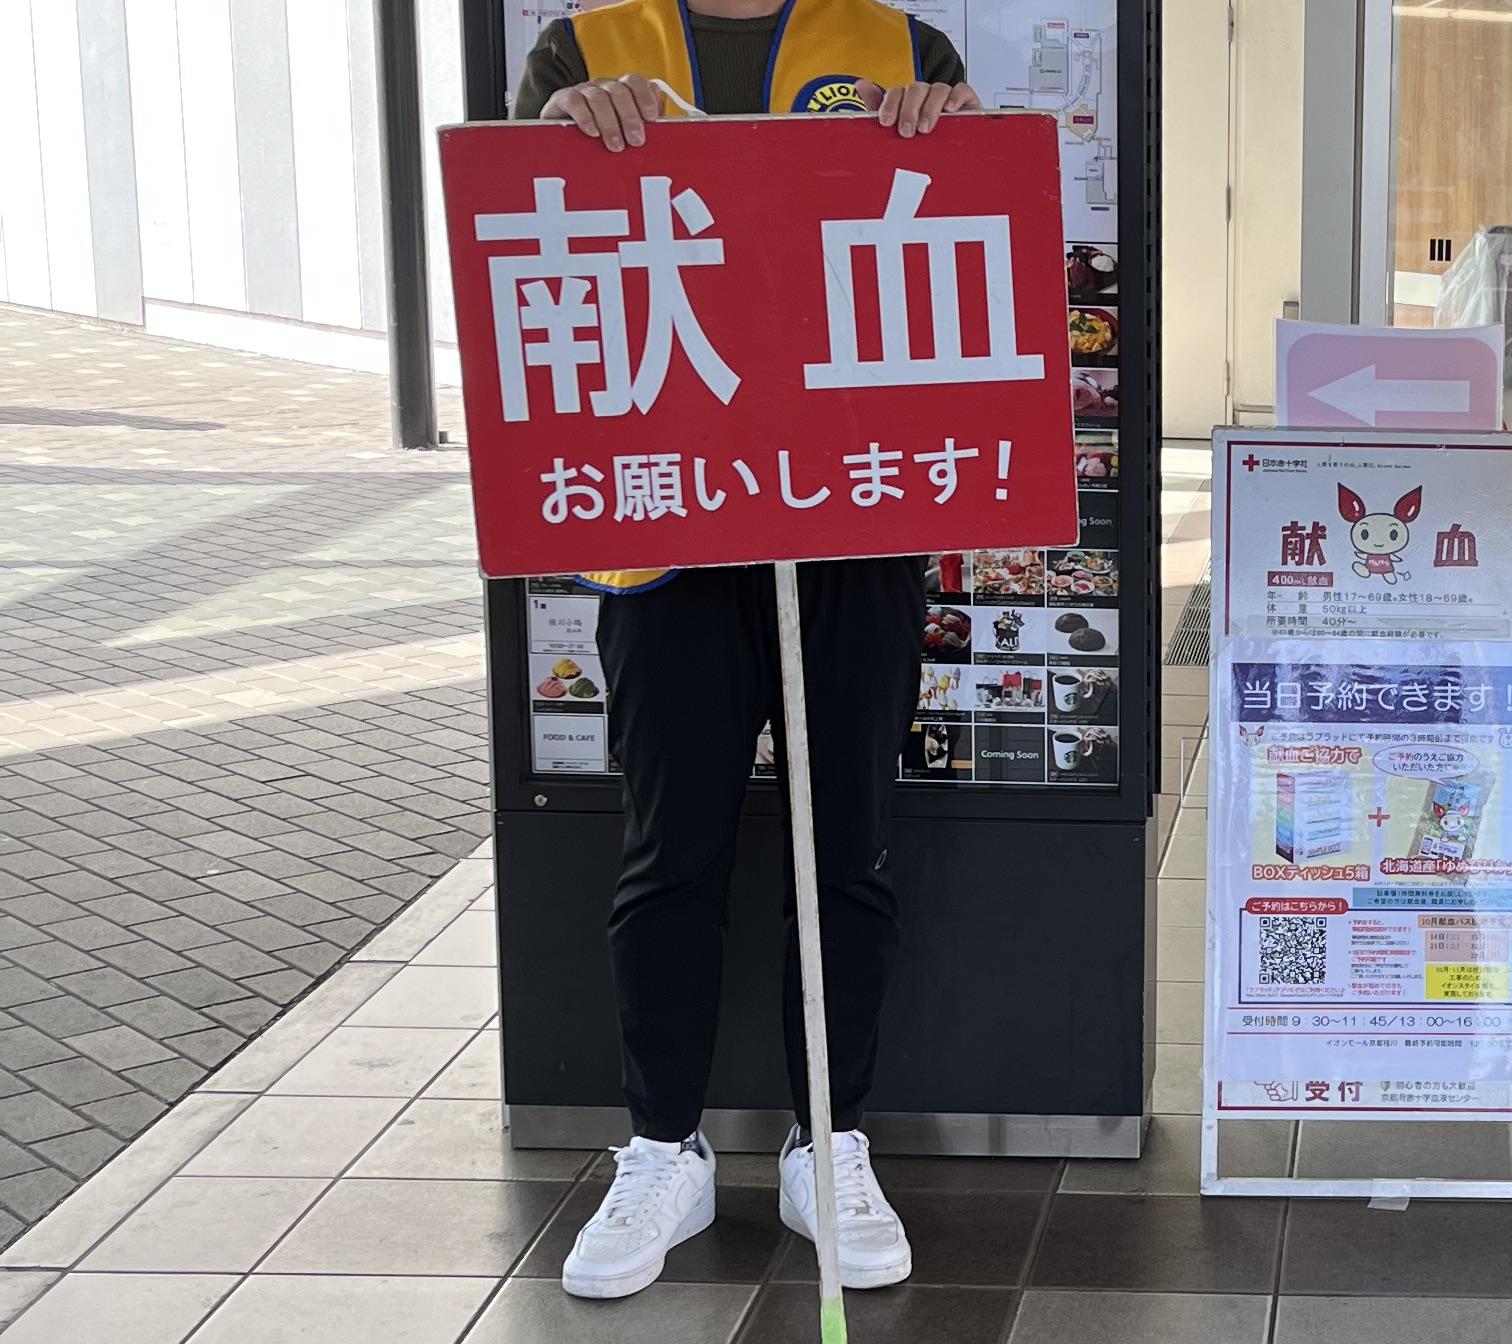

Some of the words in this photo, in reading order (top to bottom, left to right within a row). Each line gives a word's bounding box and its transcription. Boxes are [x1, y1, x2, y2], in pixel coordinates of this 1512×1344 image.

[474, 169, 1045, 423] 献血
[540, 437, 1012, 524] お願いします！
[1244, 680, 1512, 712] 当日予約できます！
[981, 749, 1014, 760] Coming
[1017, 750, 1040, 759] Soon
